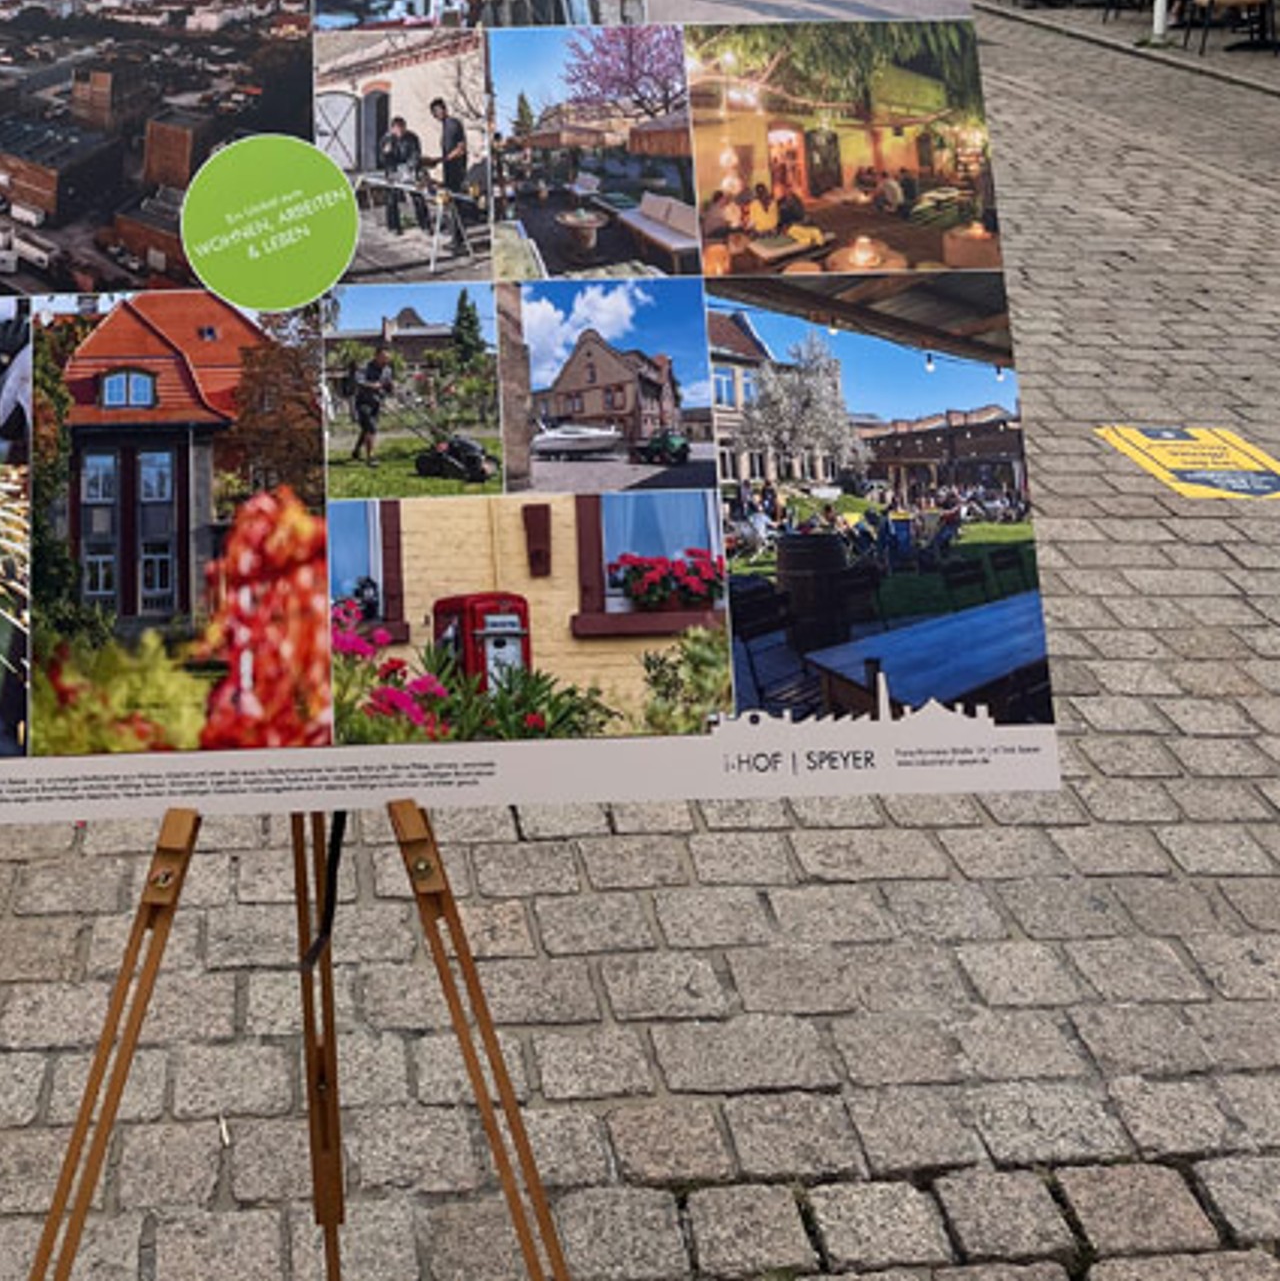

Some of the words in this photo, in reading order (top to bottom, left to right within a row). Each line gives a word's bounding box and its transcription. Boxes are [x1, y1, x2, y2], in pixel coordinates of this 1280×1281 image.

[278, 186, 348, 225] ARBEITEN
[261, 224, 312, 254] LEBEN
[806, 750, 877, 771] SPEYER
